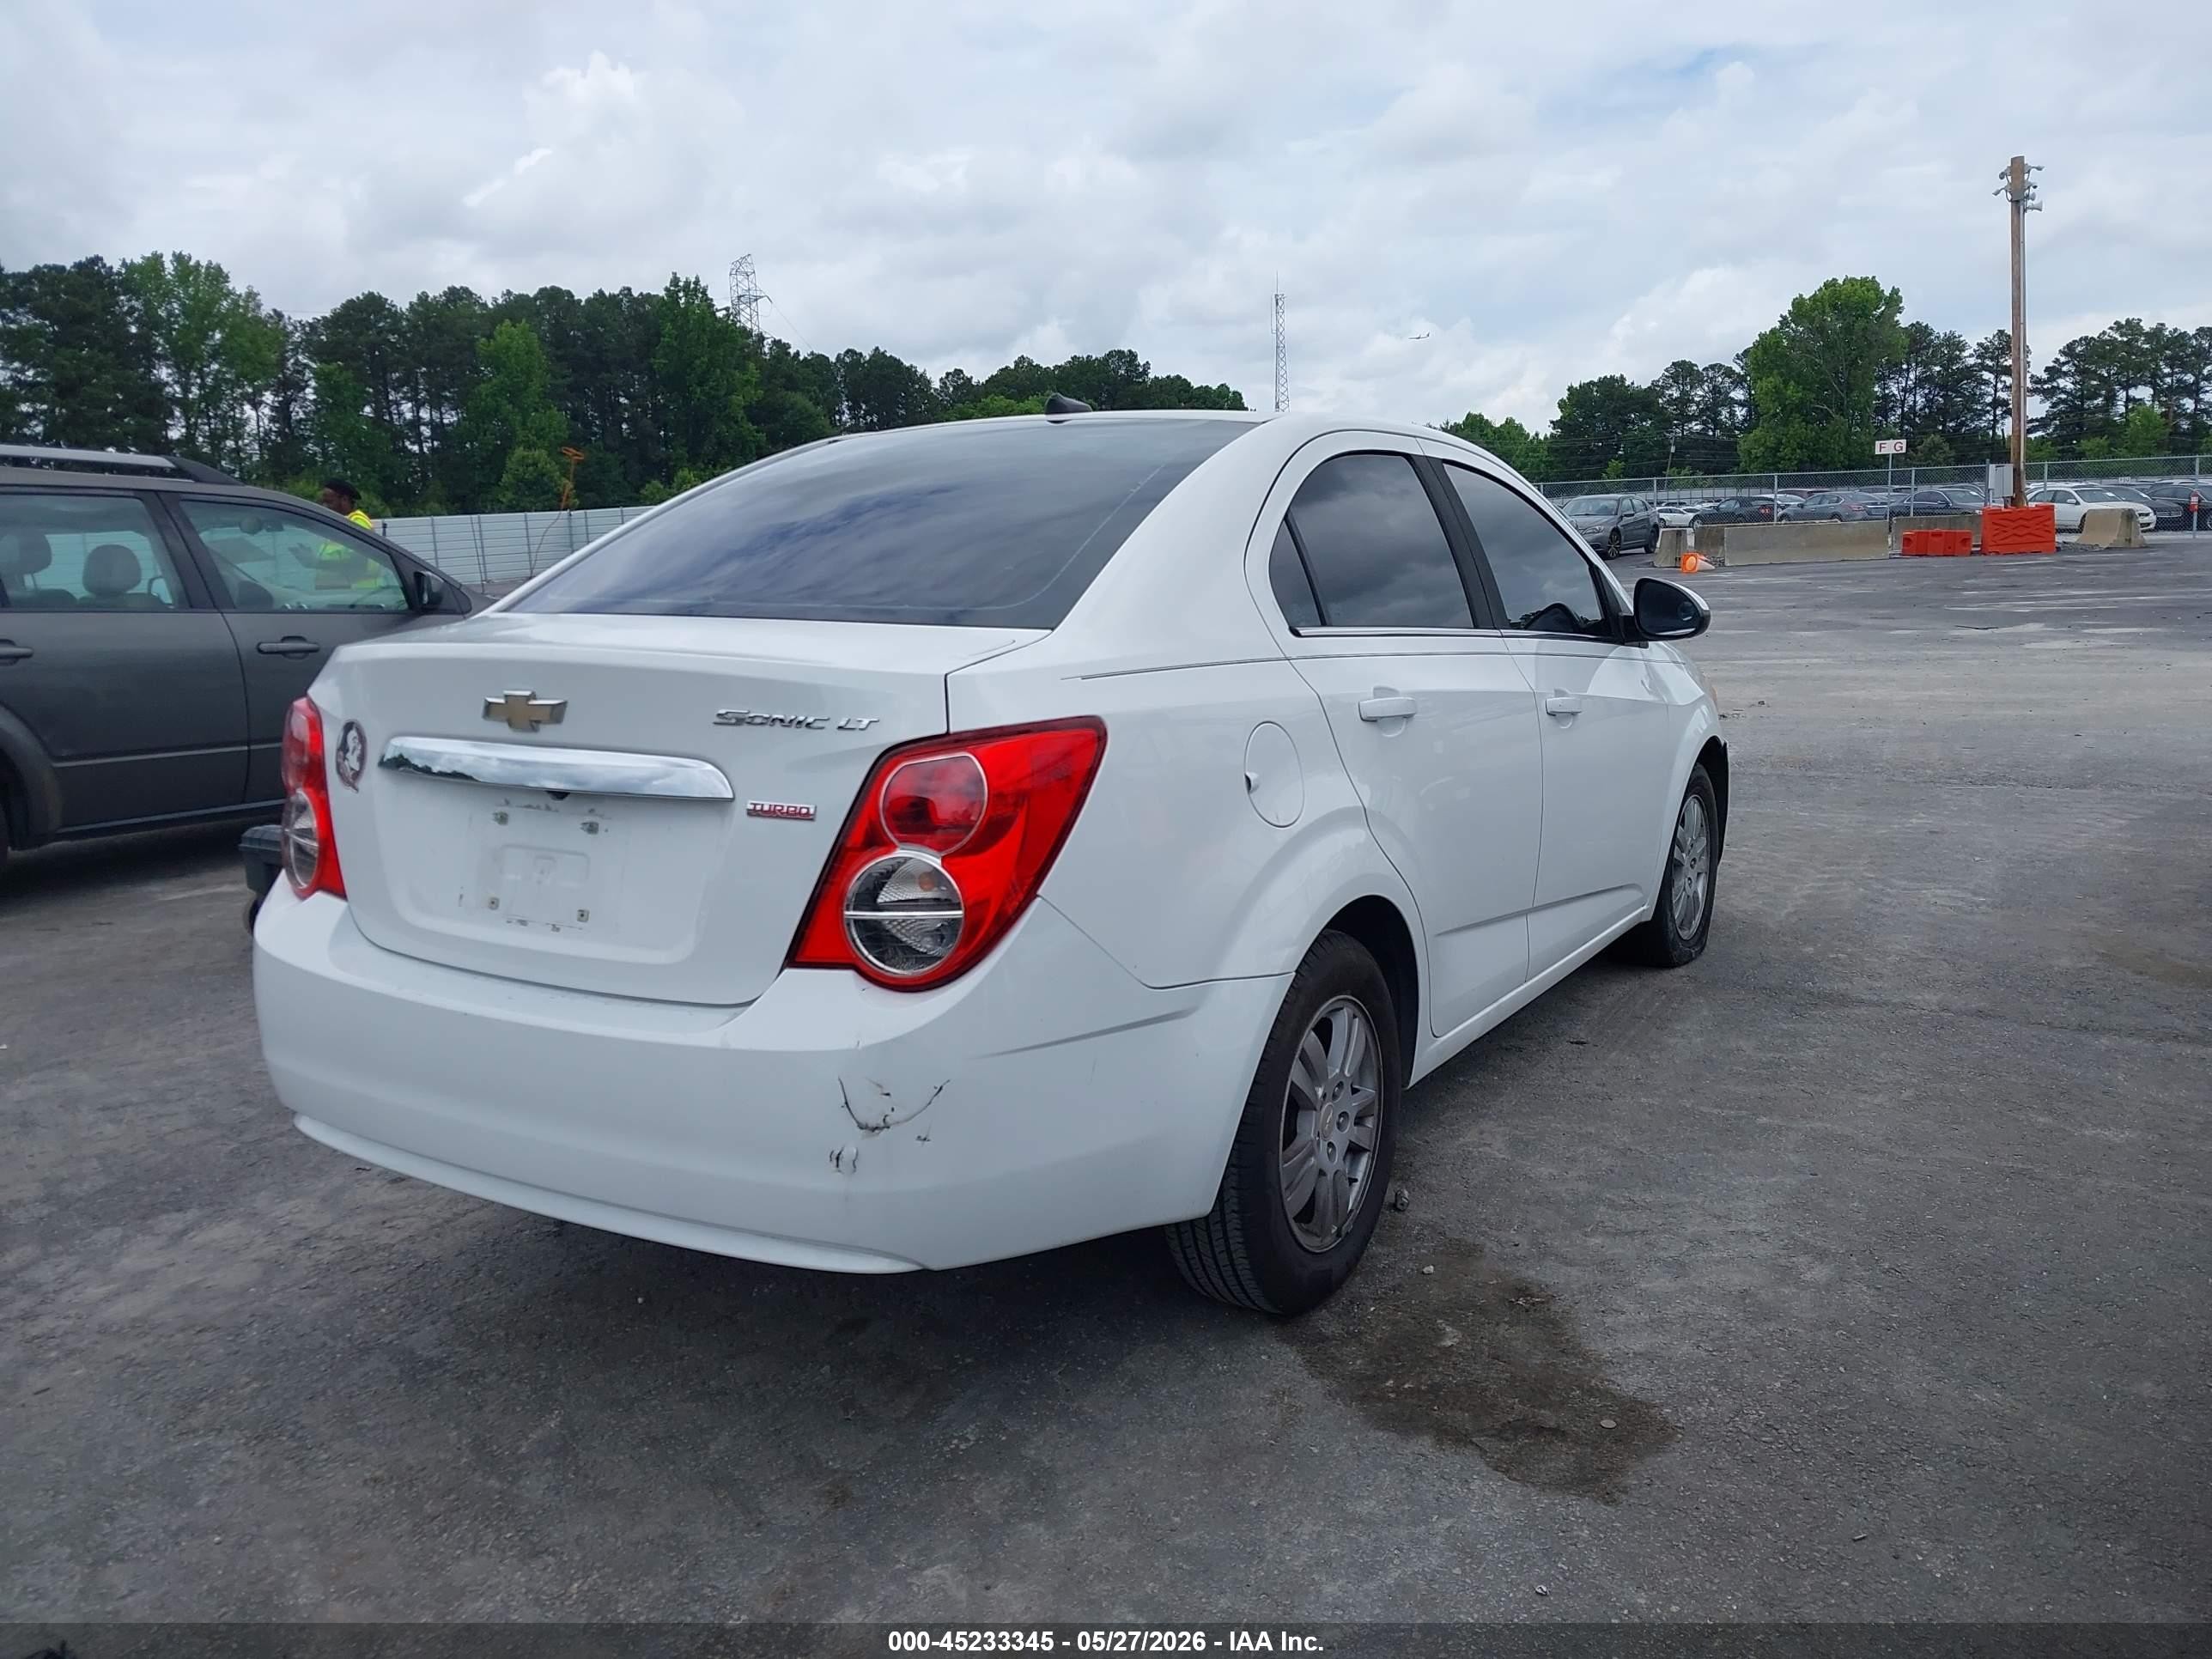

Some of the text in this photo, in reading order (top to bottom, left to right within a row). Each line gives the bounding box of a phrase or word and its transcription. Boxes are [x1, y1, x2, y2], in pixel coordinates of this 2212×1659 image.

[1879, 441, 1904, 453] F G
[836, 717, 880, 731] LT
[748, 801, 812, 818] TURBO
